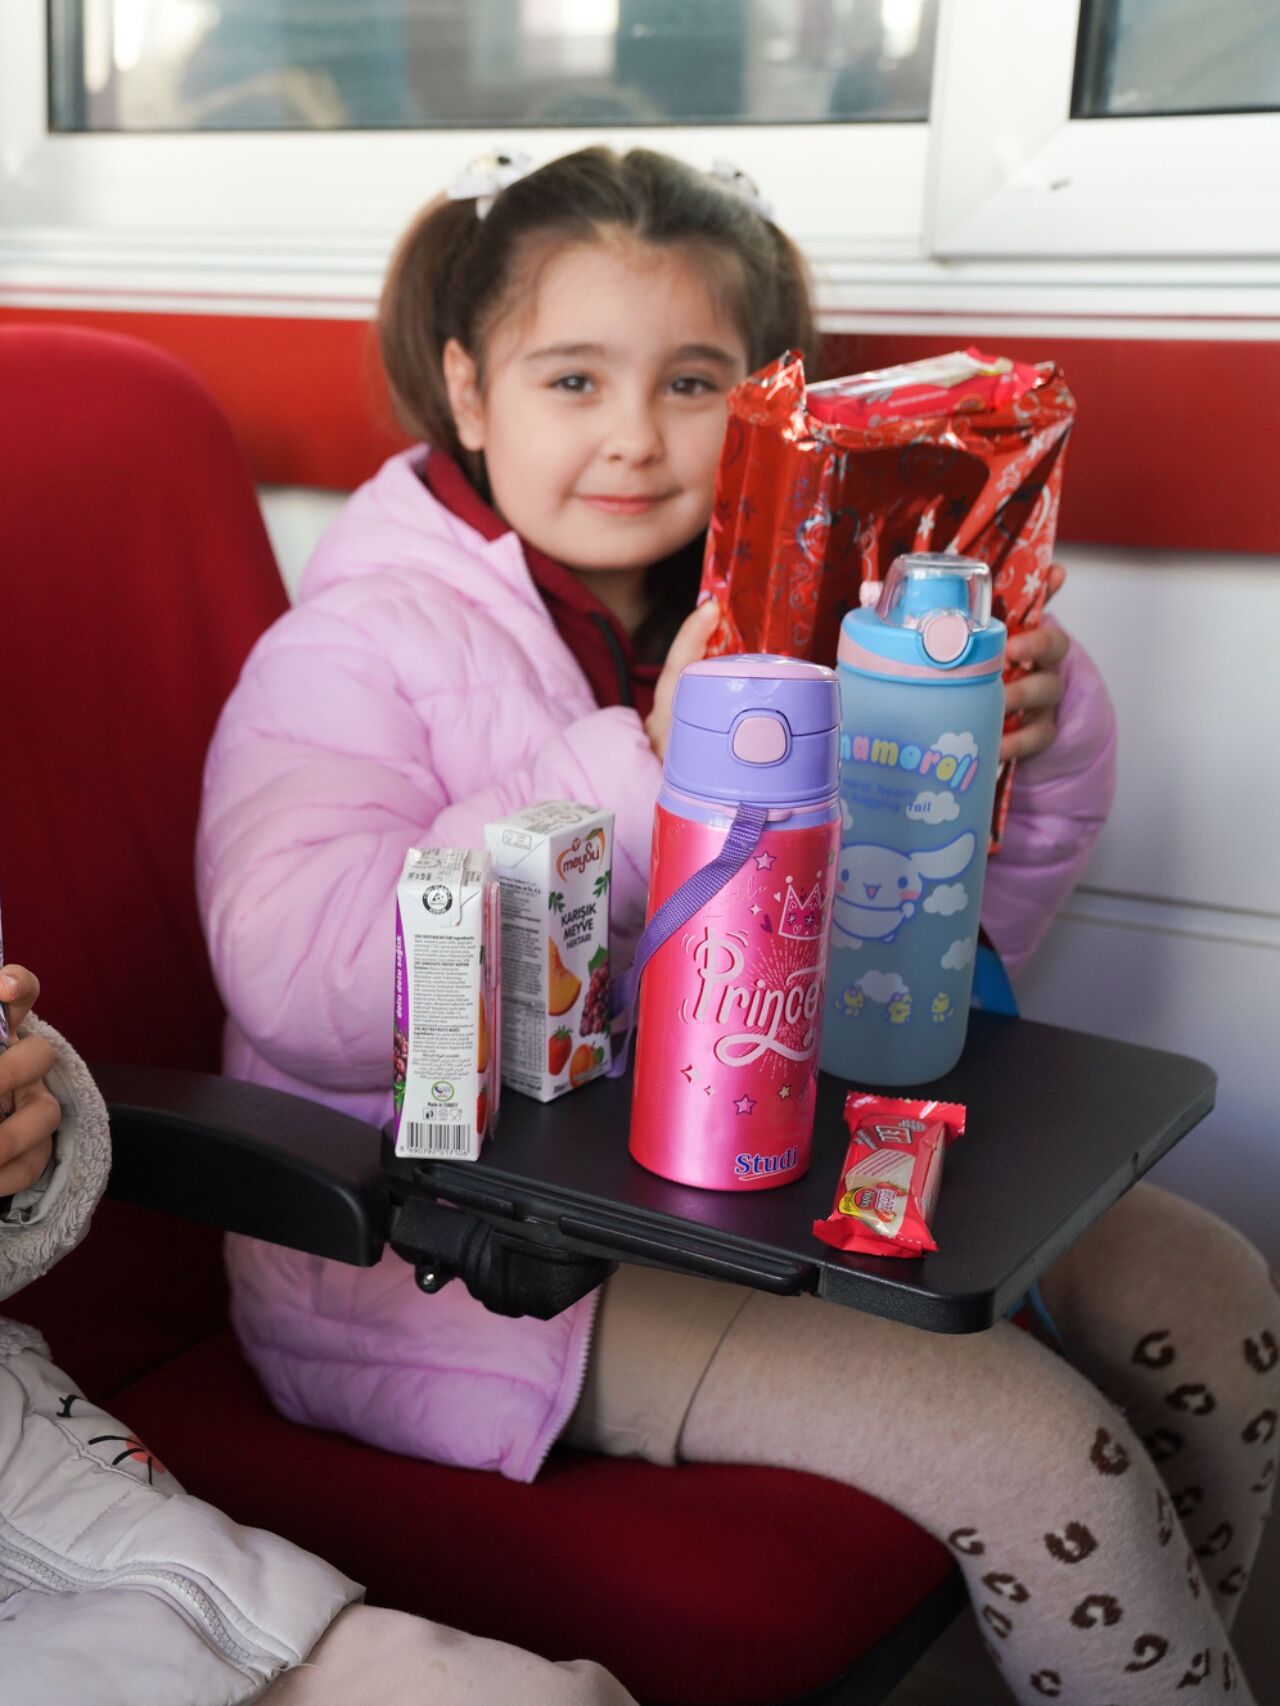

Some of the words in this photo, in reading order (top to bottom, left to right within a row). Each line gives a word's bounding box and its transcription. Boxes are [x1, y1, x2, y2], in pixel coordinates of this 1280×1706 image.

[908, 801, 932, 813] tail
[561, 903, 596, 926] KARIŞIK
[563, 918, 593, 940] MEYVE
[734, 1144, 799, 1175] Studi
